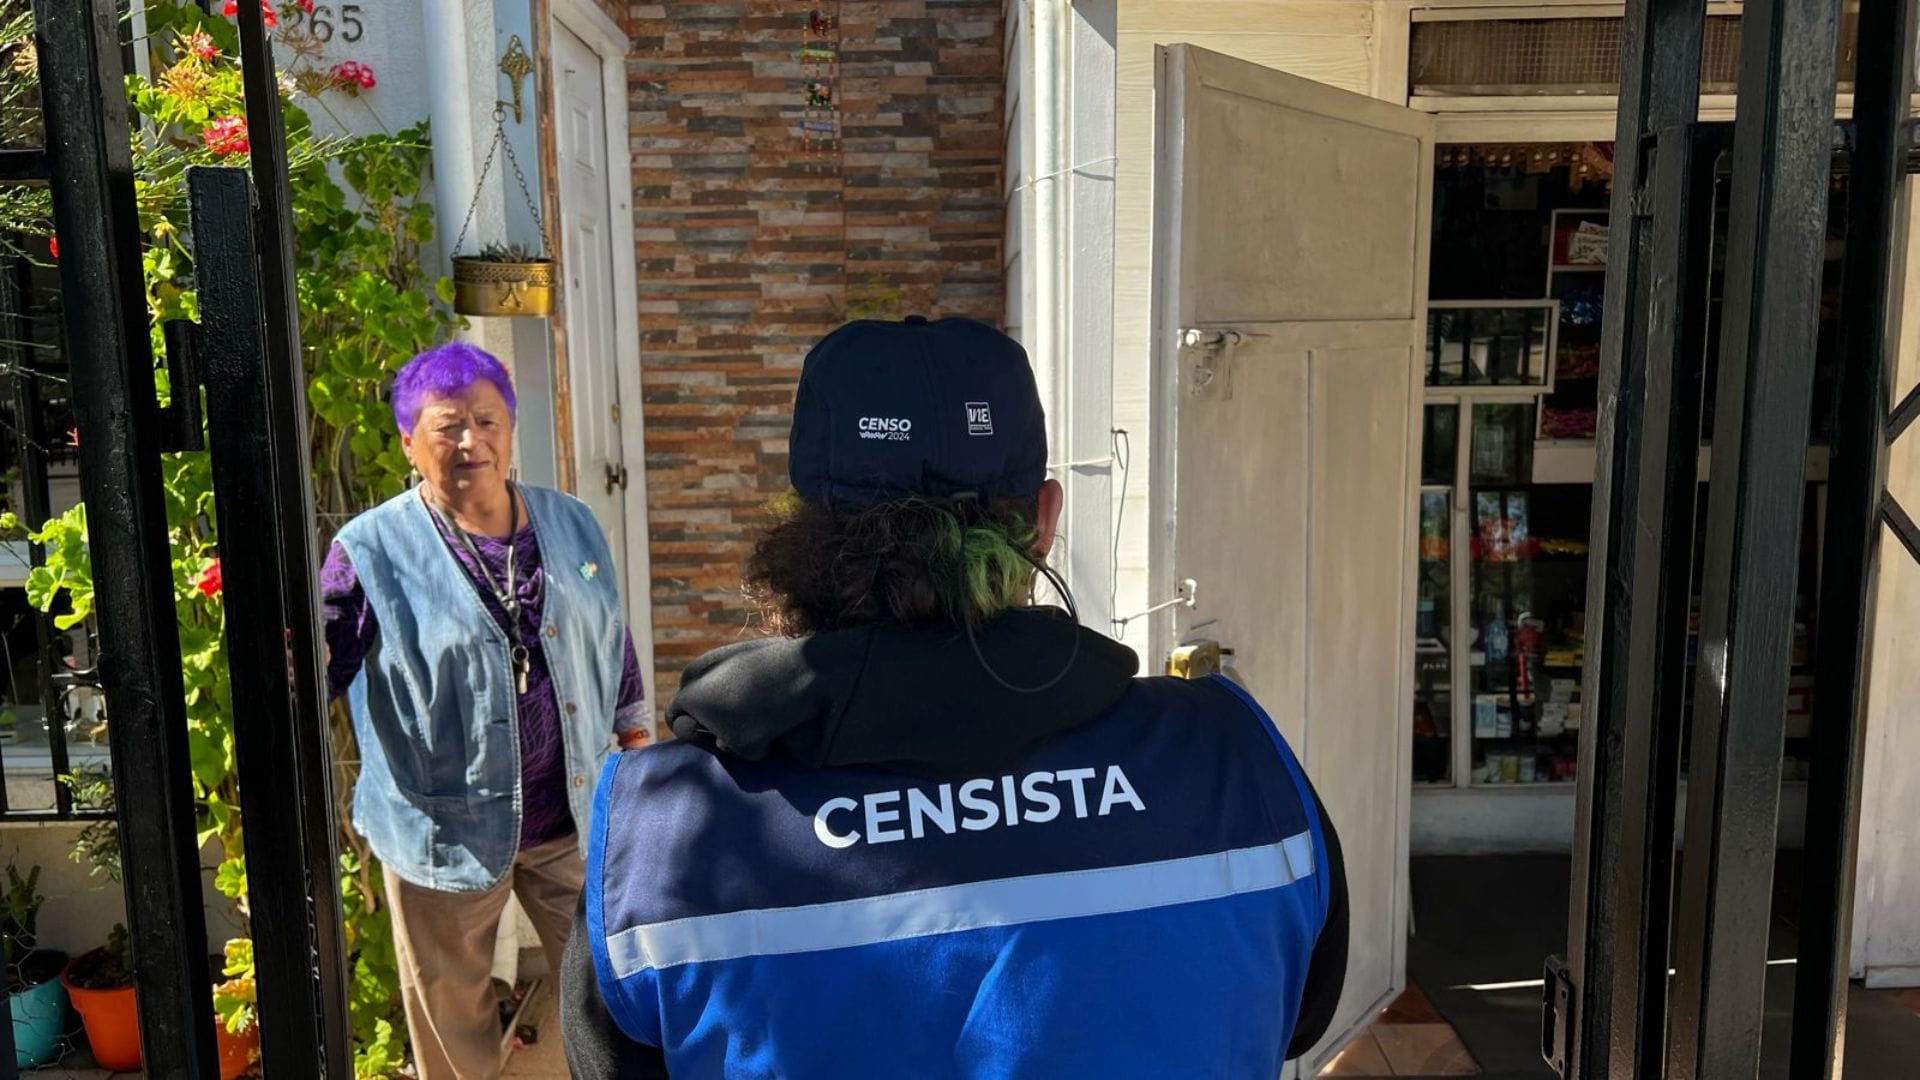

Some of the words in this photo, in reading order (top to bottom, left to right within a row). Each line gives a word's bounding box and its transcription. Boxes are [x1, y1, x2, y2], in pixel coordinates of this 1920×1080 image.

[858, 417, 912, 432] CENSO
[887, 432, 911, 441] 2024
[814, 765, 1146, 849] CENSISTA
